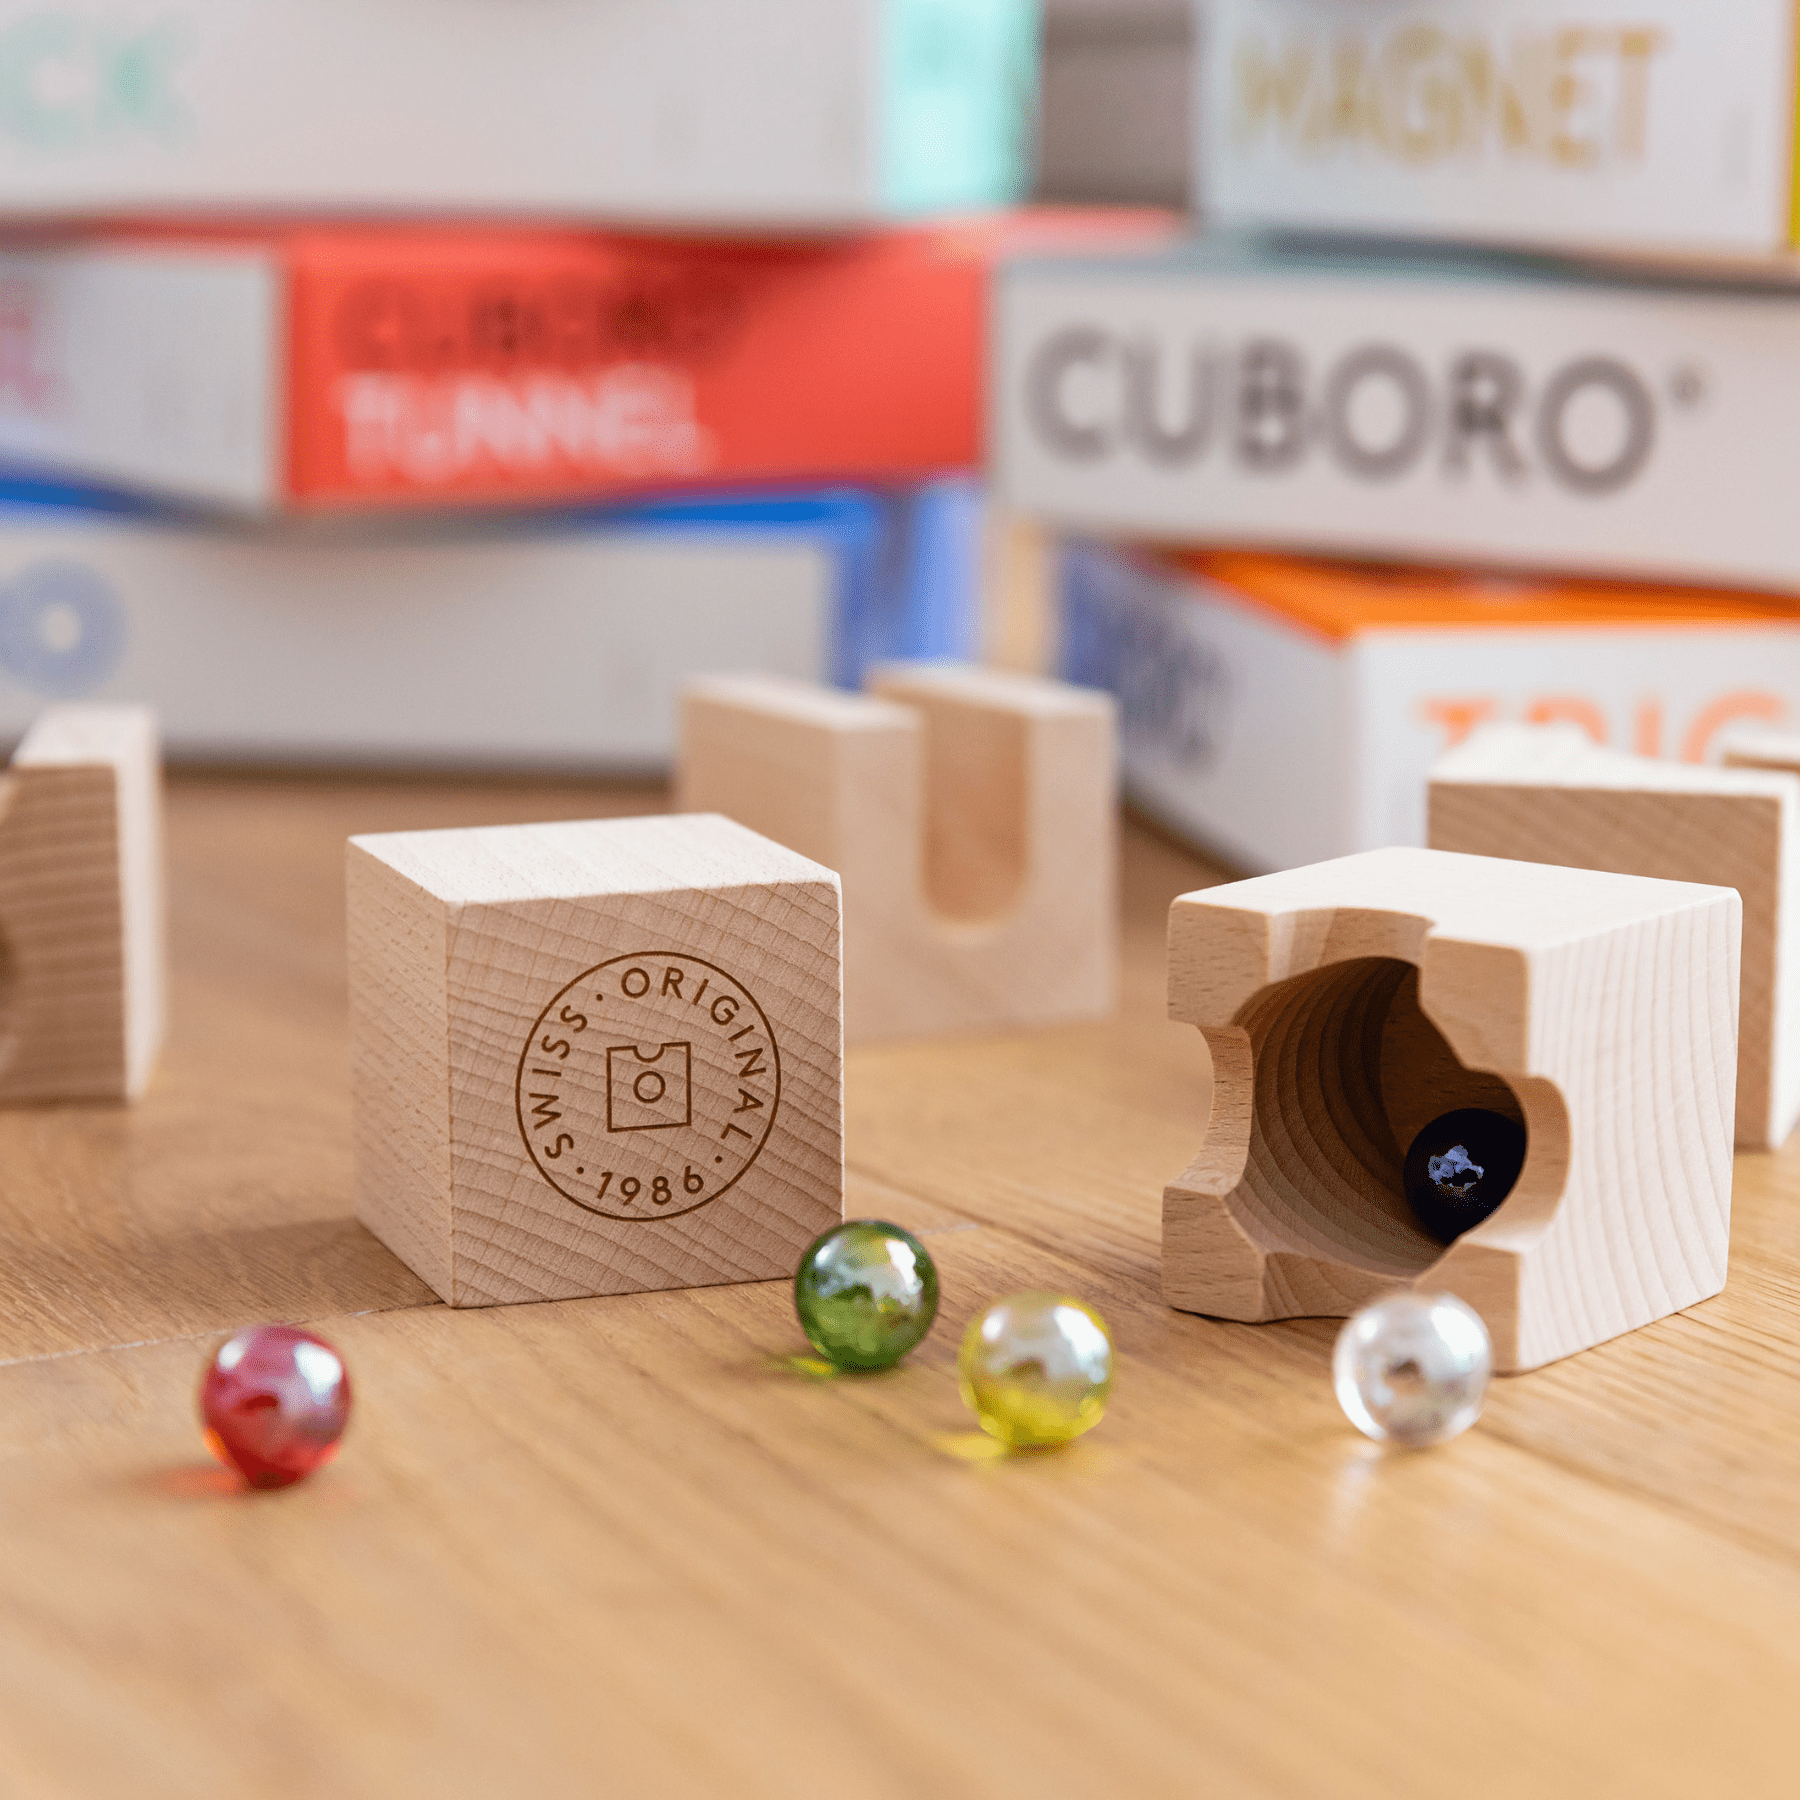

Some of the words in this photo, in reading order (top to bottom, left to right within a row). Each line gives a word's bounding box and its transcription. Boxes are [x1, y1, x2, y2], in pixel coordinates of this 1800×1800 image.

[1230, 22, 1668, 168] MAGNET
[528, 1004, 588, 1160] SWISS
[620, 966, 768, 1141] ORIGINAL
[596, 1164, 705, 1207] 1986
